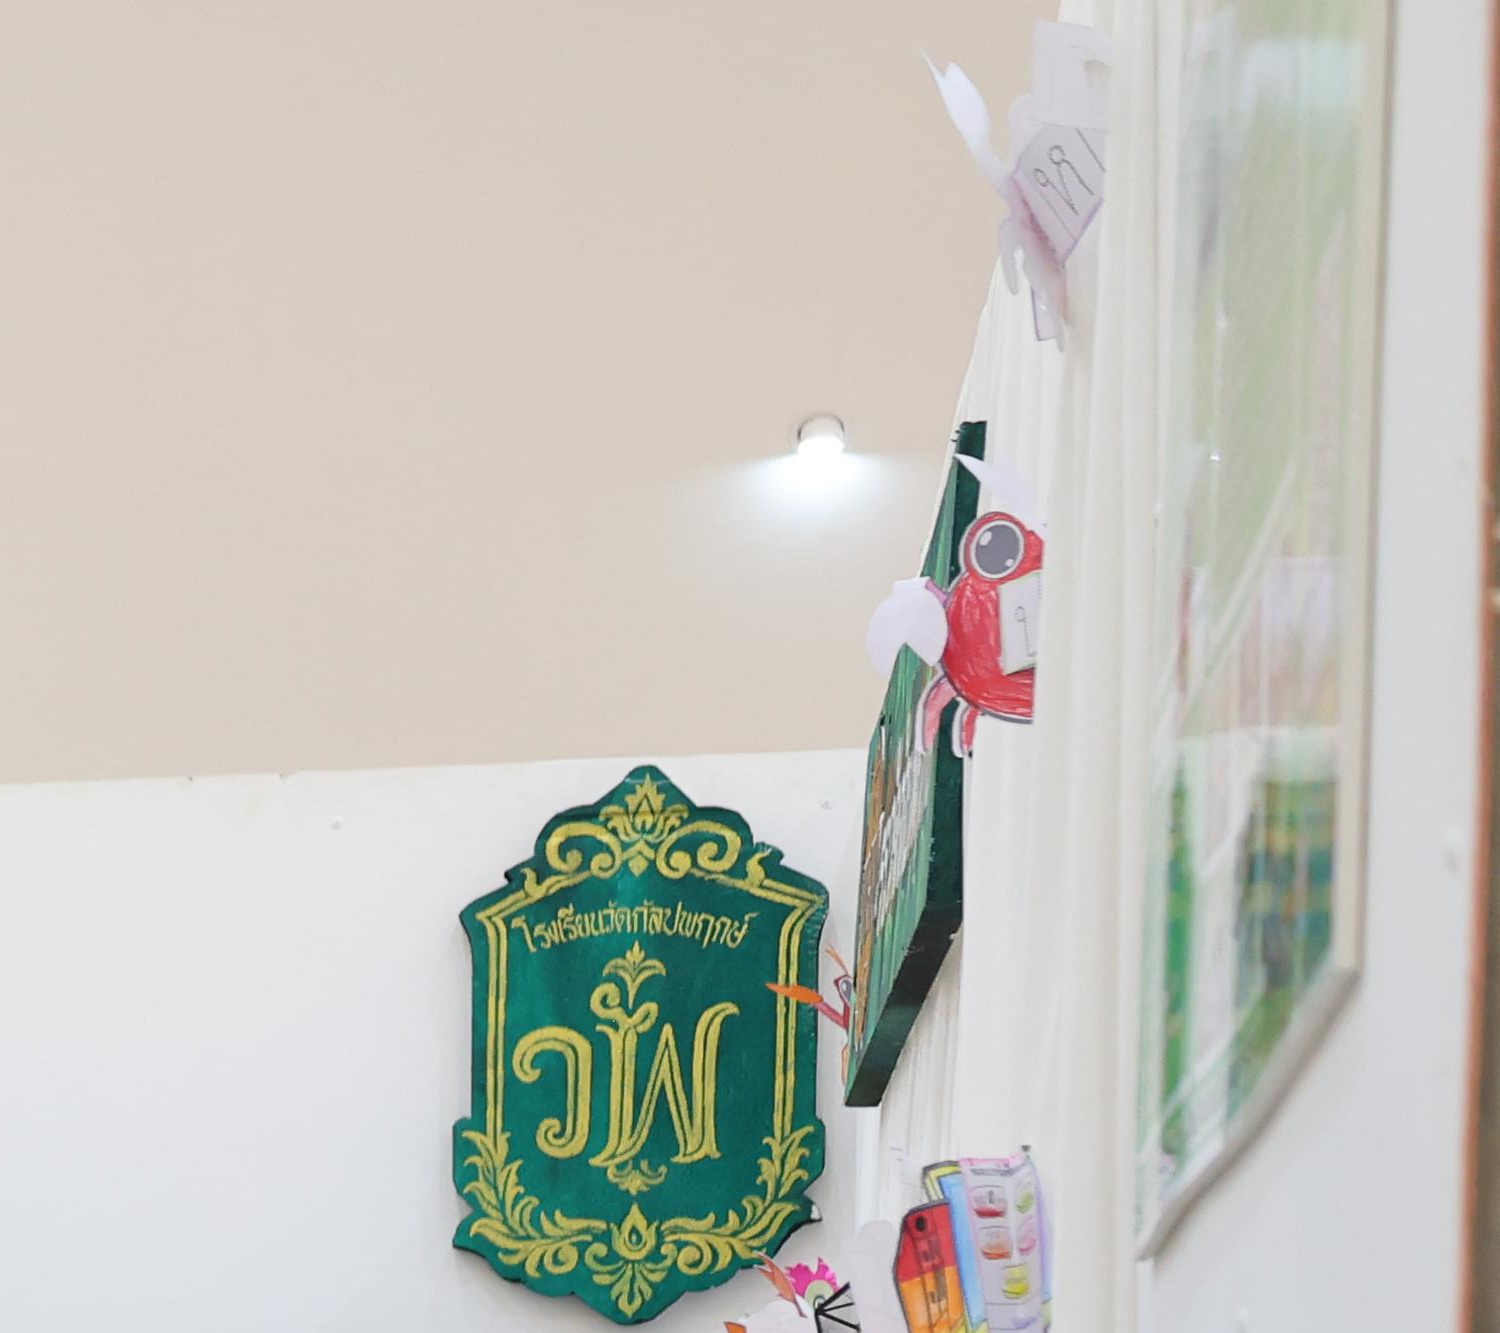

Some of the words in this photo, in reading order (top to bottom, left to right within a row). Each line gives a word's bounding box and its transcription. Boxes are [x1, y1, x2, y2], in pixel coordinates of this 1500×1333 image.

[512, 900, 758, 954] โรงเรียนวัดกัลปพฤกษ์
